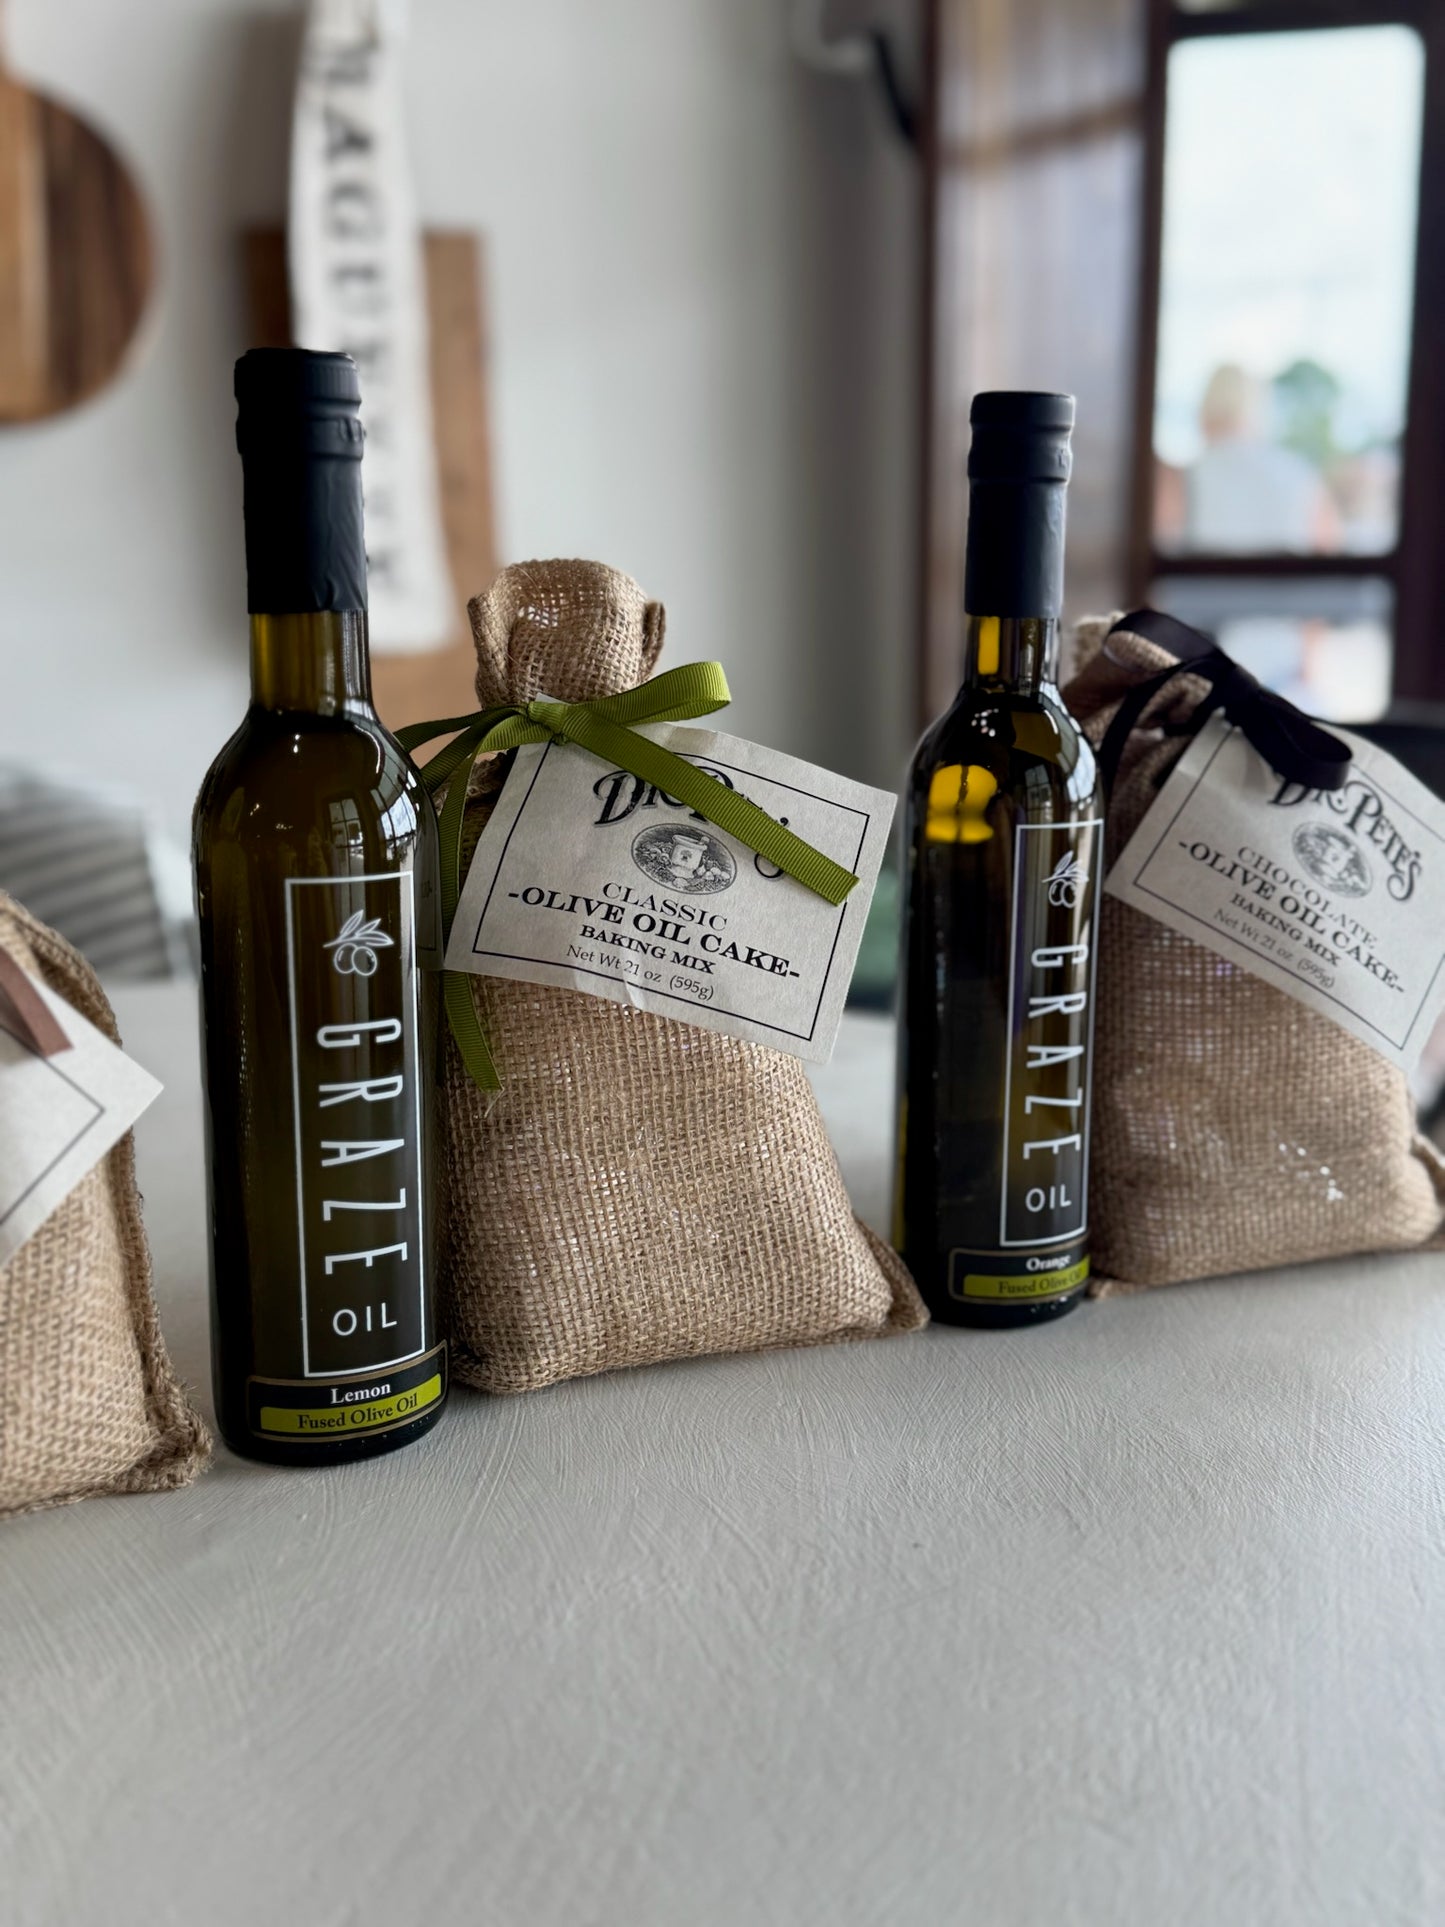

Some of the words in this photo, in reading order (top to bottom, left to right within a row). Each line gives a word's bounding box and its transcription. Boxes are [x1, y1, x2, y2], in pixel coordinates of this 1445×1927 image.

[602, 881, 728, 931] CLASSIC
[1178, 840, 1277, 900] -OLIVE
[1280, 895, 1327, 935] OIL
[1331, 930, 1405, 993] CAKE-
[1237, 846, 1378, 950] CHOCOLATE
[508, 886, 626, 925] -OLIVE
[633, 913, 692, 945] OIL
[700, 933, 801, 979] CAKE-
[579, 924, 666, 960] BAKING
[672, 951, 717, 975] MIX
[1214, 908, 1238, 929] Net
[1241, 922, 1261, 942] Wt
[1262, 935, 1277, 951] 21
[1277, 946, 1294, 961] oz
[1297, 958, 1336, 990] (595g)
[1230, 893, 1302, 942] BAKING
[1304, 938, 1342, 967] MIX
[567, 944, 596, 963] Net
[600, 951, 621, 970] Wt
[624, 961, 641, 977] 21
[644, 970, 662, 983] oz
[669, 974, 715, 1001] (595g)
[1023, 944, 1089, 1160] GRAZE
[317, 1018, 408, 1275] GRAZE
[1025, 1184, 1072, 1212] OIL
[998, 1279, 1037, 1294] Fused
[1039, 1276, 1067, 1290] Olive
[1026, 1254, 1072, 1272] Orange
[332, 1302, 398, 1336] OIL
[297, 1413, 346, 1429] Fused
[350, 1406, 394, 1425] Olive
[397, 1393, 418, 1413] Oil
[330, 1383, 392, 1405] Lemon
